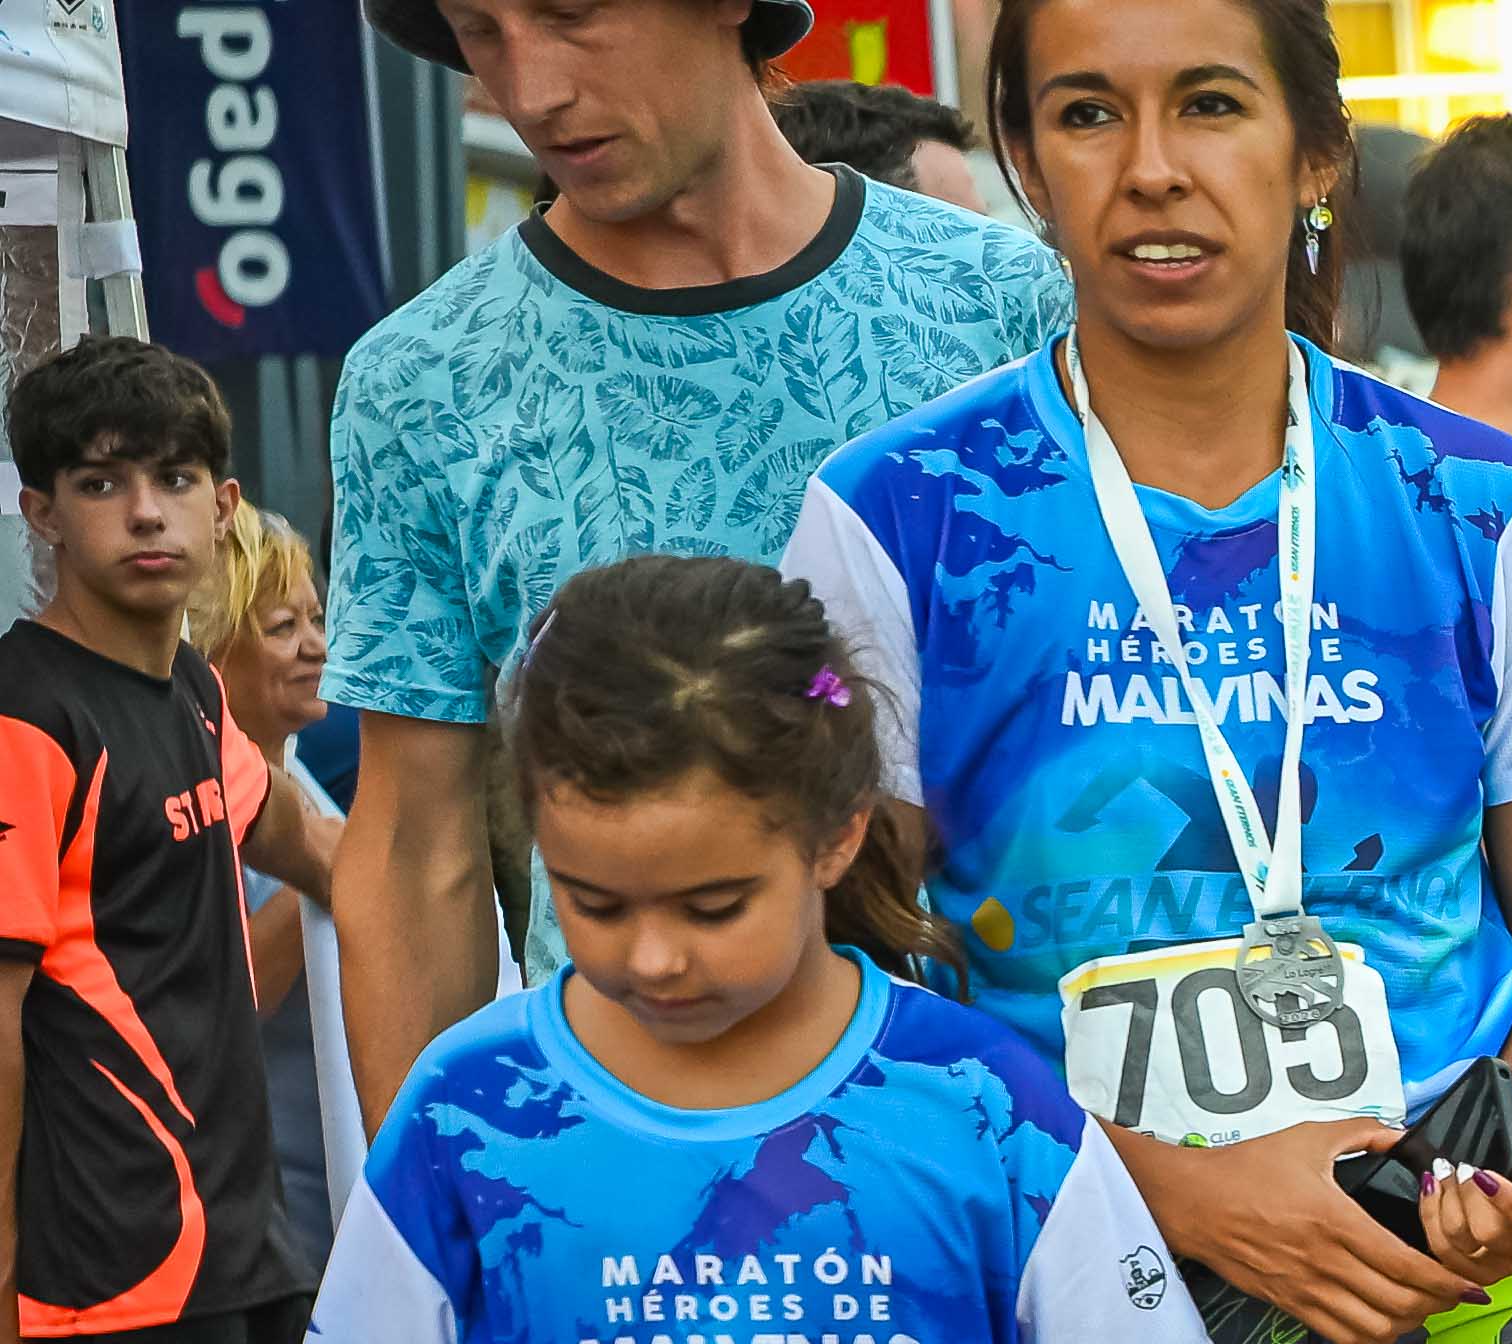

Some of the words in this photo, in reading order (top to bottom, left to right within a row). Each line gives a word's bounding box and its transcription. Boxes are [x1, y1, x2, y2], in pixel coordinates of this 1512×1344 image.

[178, 7, 290, 306] pago
[1061, 669, 1385, 727] MALVINAS
[1080, 967, 1369, 1128] 705
[1210, 1131, 1241, 1143] CLUB
[602, 1247, 892, 1288] MARATÓN
[606, 1289, 805, 1323] HÉROES
[833, 1294, 891, 1321] DE
